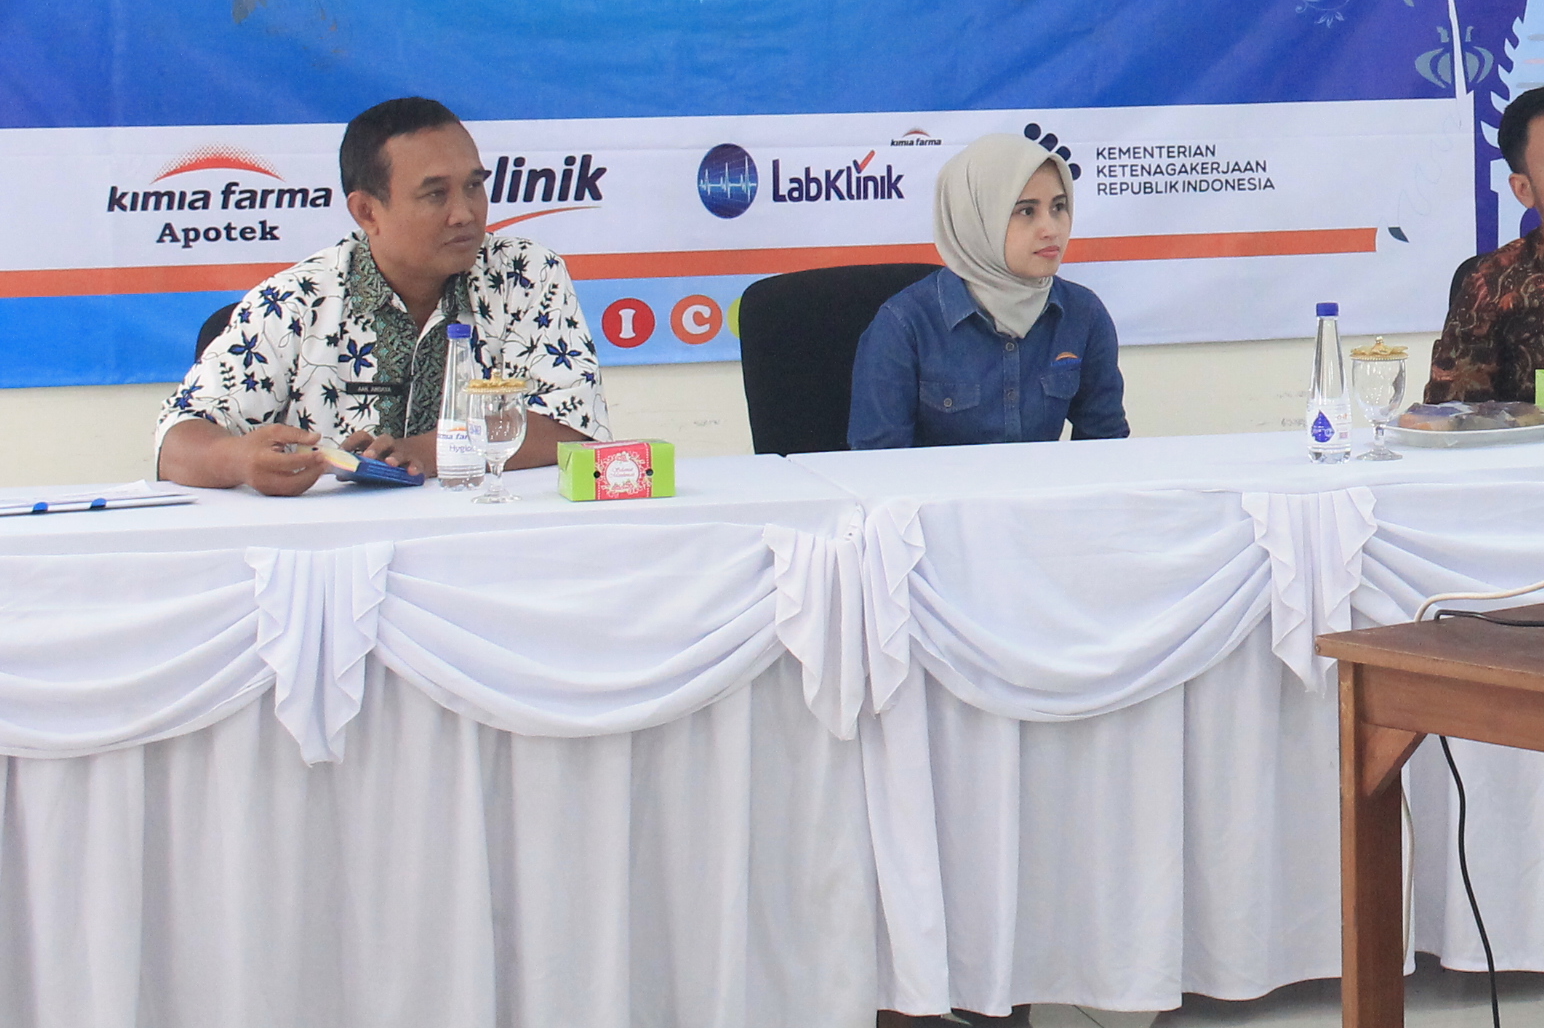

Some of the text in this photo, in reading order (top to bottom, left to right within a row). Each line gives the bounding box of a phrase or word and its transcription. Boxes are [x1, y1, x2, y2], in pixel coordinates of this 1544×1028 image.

[890, 137, 942, 147] kimia farma
[1096, 144, 1217, 161] KEMENTERIAN
[484, 153, 608, 204] linik
[772, 150, 905, 204] LabKlinik
[1096, 159, 1268, 179] KETENAGAKERJAAN
[106, 181, 334, 213] kimia farma
[1097, 176, 1276, 196] REPUBLIK INDONESIA
[156, 219, 281, 249] Apotek
[618, 303, 712, 340] I C
